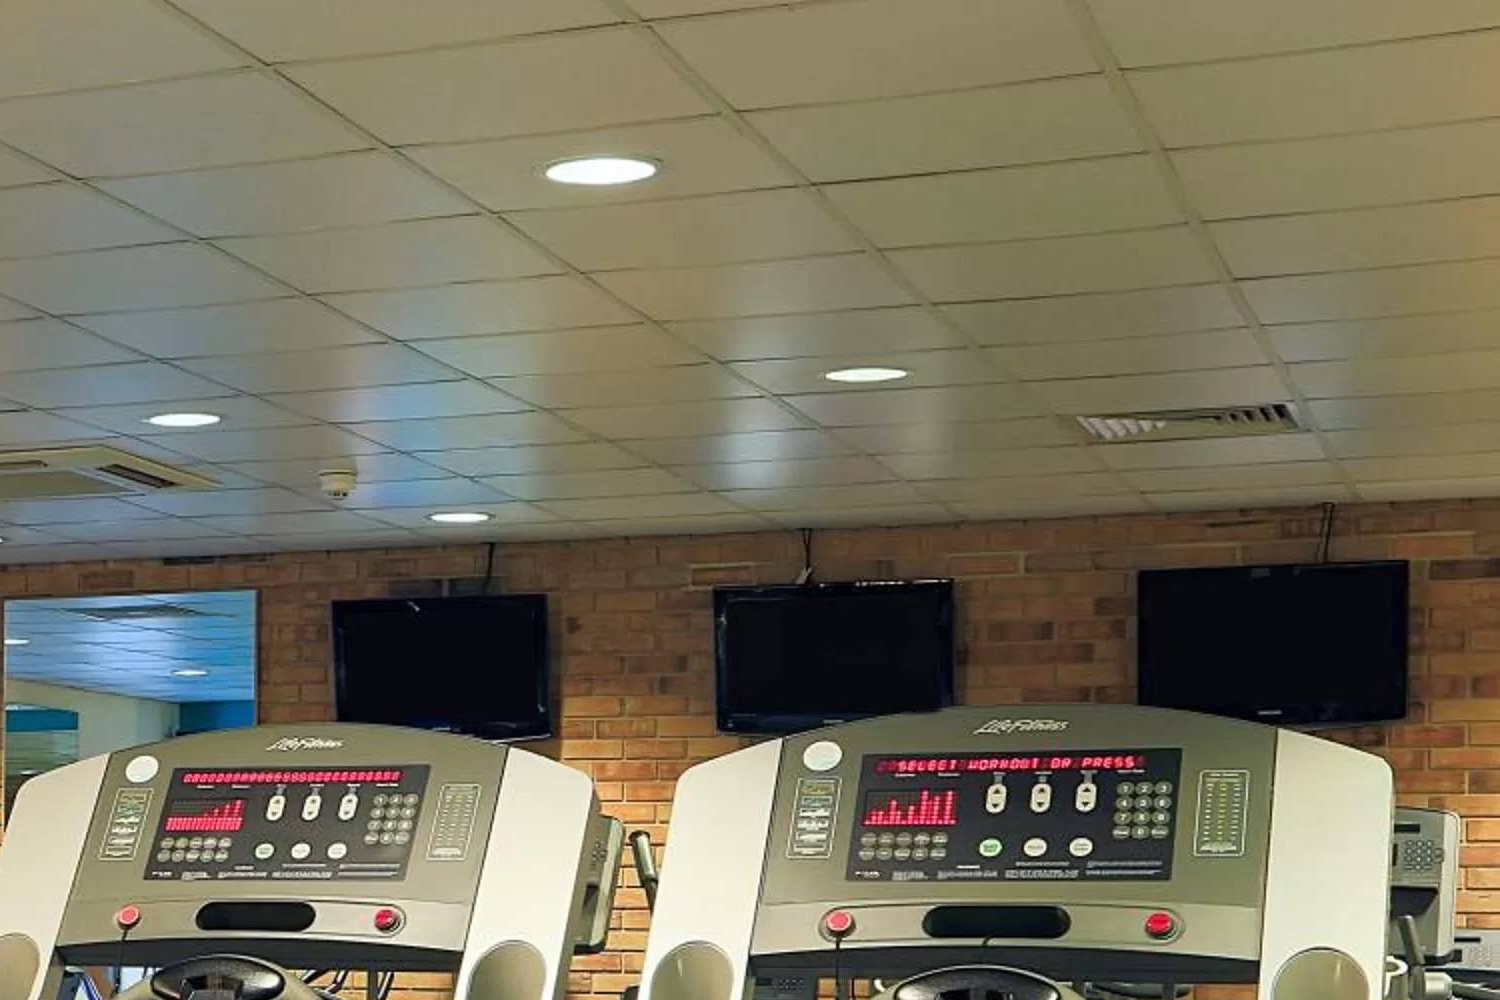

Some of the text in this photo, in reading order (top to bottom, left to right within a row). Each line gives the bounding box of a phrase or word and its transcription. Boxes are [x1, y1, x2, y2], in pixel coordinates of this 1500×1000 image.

[898, 755, 1136, 771] SELECT WORKOUT OR PRESS
